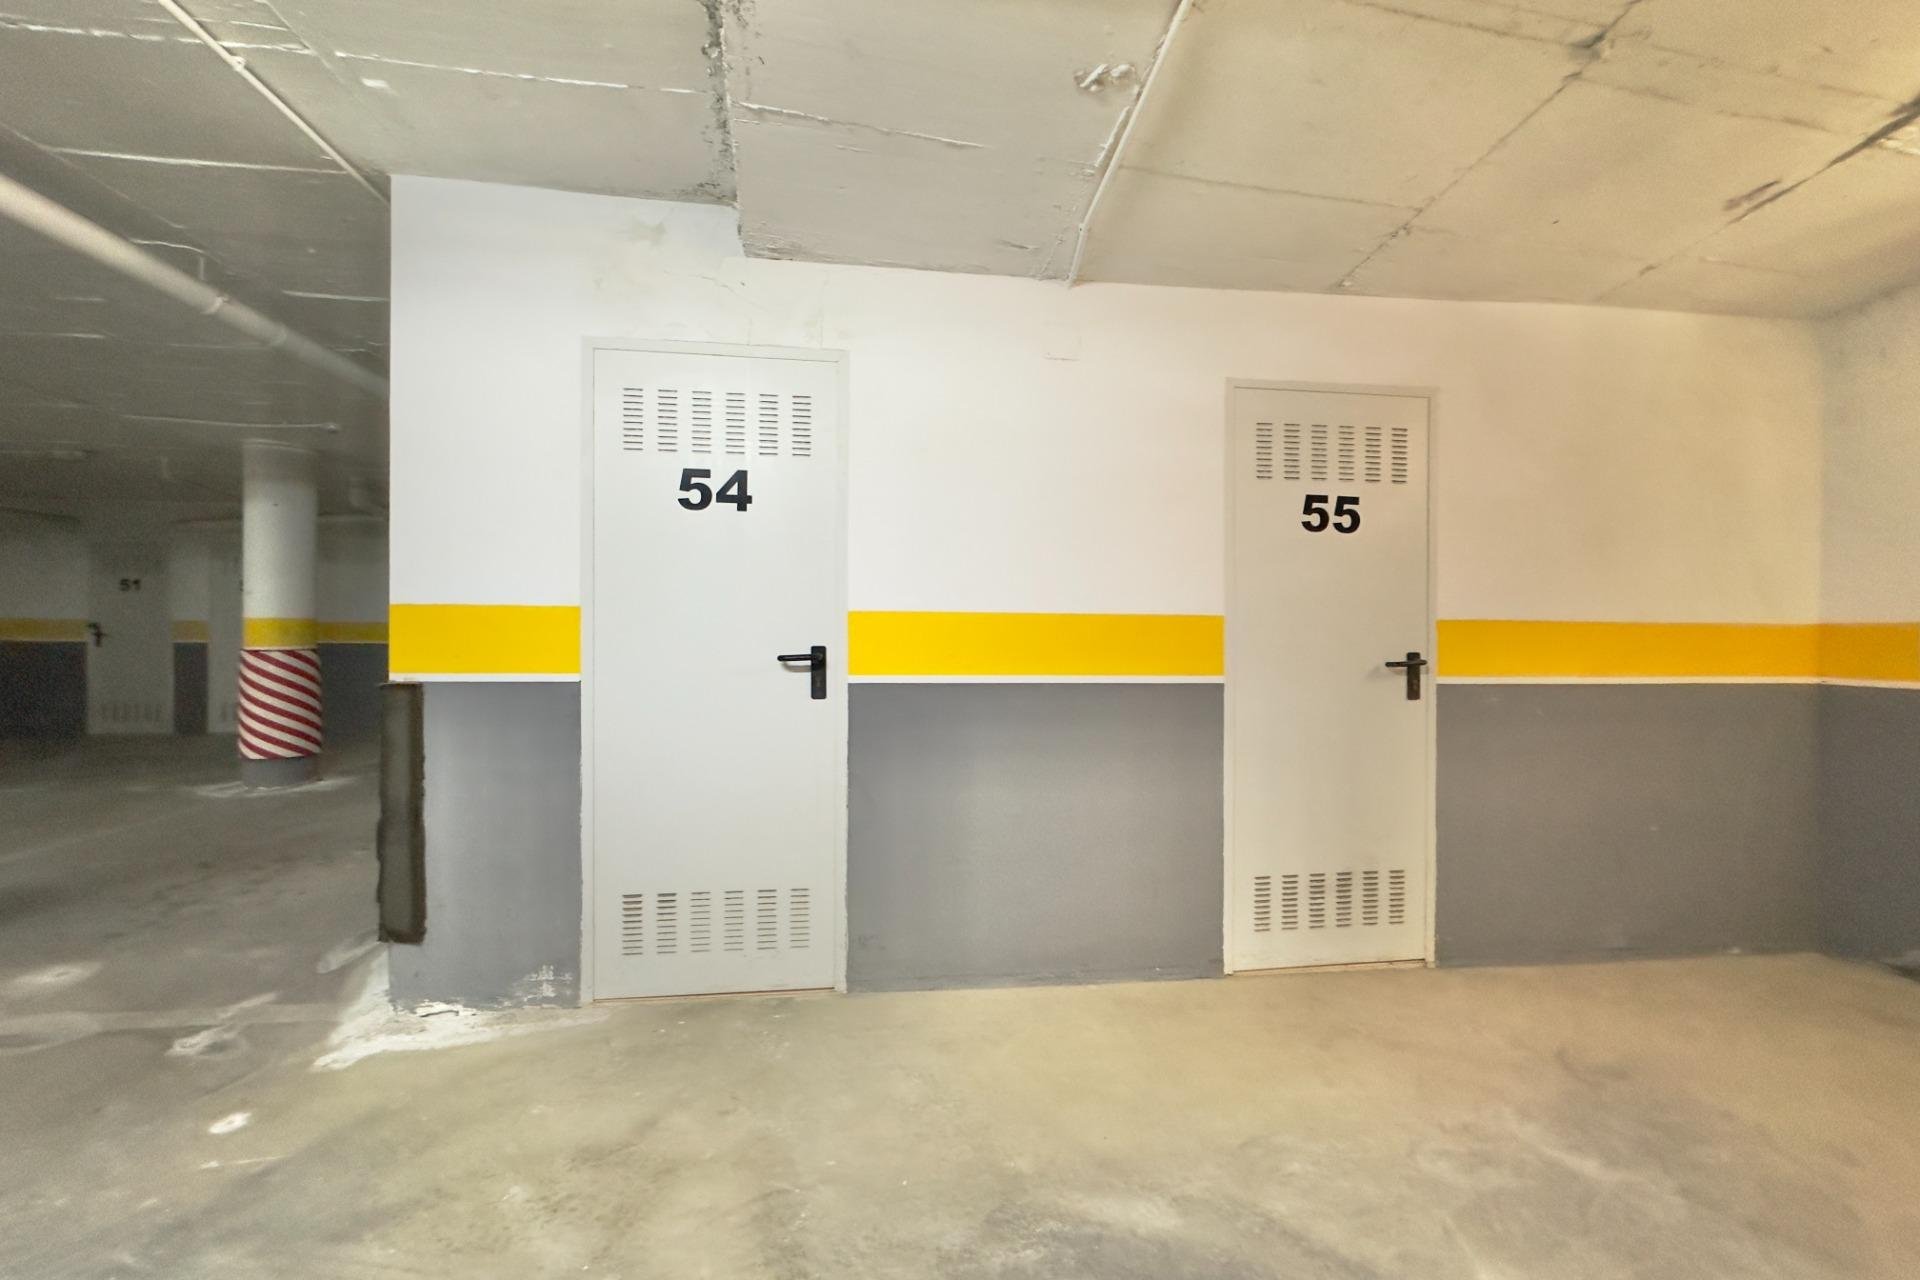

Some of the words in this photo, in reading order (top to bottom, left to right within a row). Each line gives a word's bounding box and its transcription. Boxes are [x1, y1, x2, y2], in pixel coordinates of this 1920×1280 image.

[678, 468, 752, 512] 54
[1301, 494, 1360, 533] 55
[119, 578, 141, 592] 51
